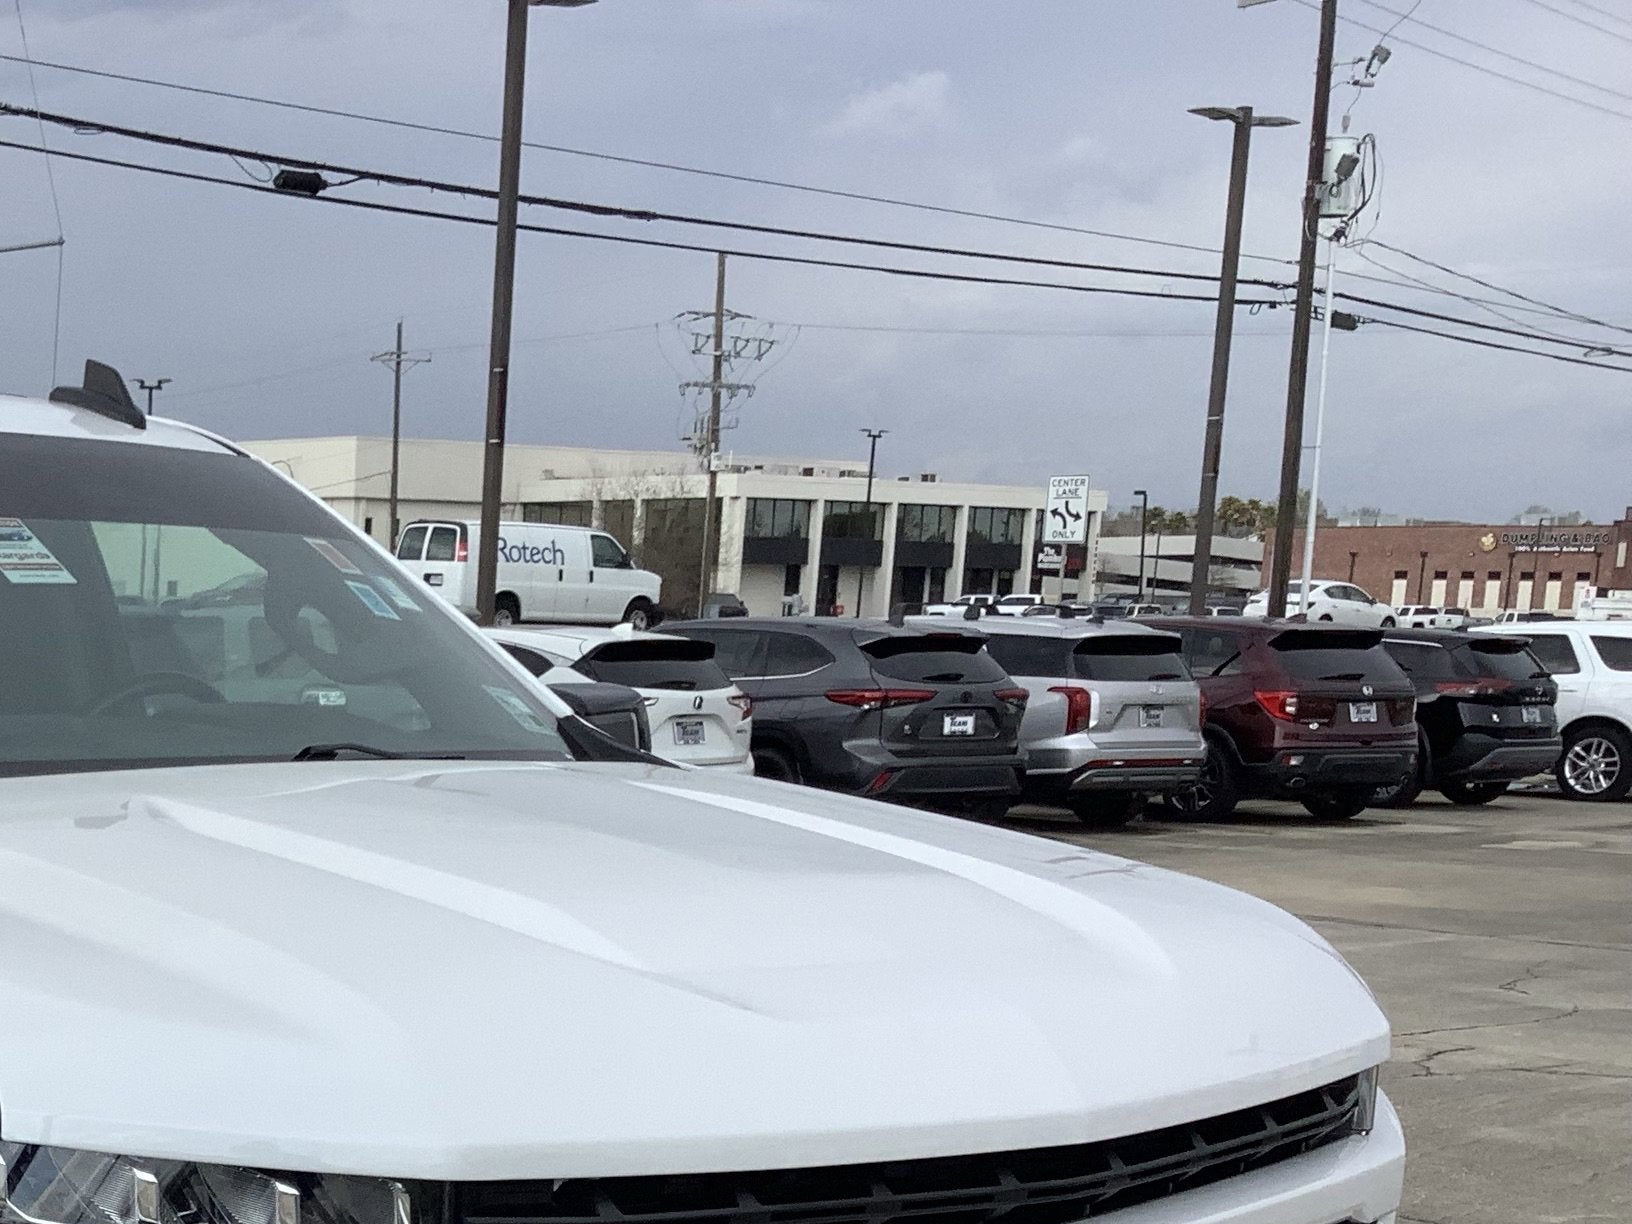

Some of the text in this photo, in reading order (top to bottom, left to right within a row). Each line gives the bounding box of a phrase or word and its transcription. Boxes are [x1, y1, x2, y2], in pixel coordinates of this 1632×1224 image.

[1052, 479, 1086, 487] CENTER
[1056, 488, 1080, 497] LANE
[1052, 530, 1076, 539] ONLY
[1501, 533, 1569, 544] DUMPLING
[497, 537, 565, 566] Rotech
